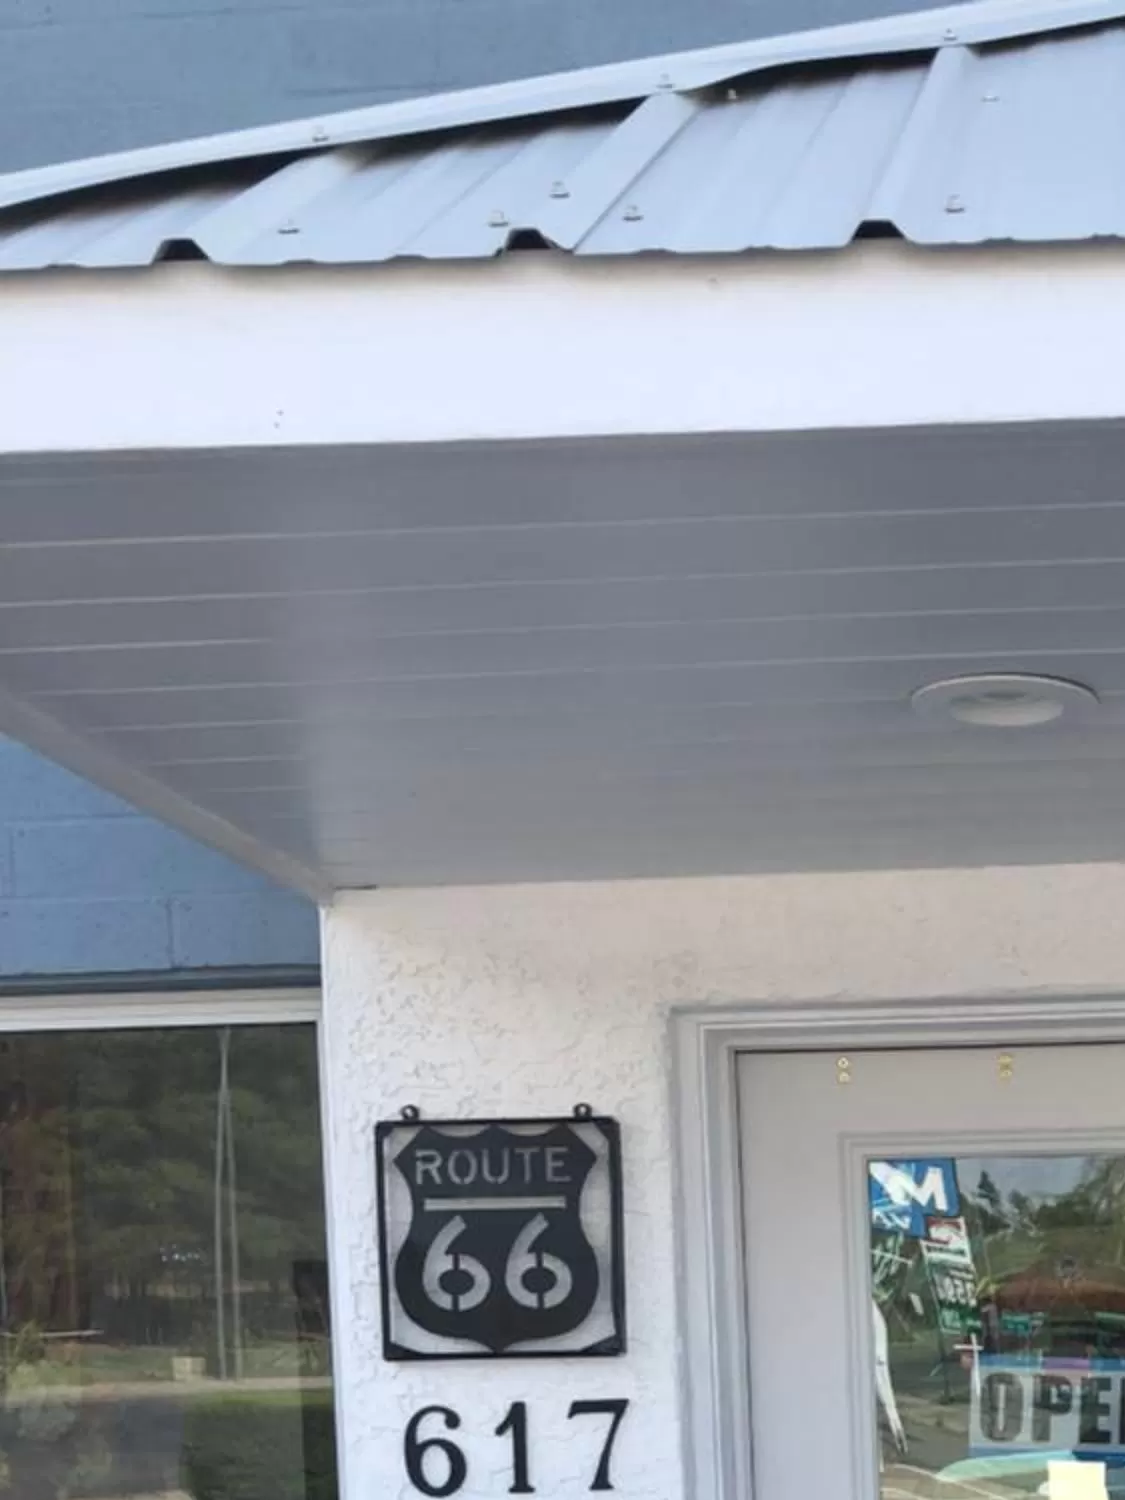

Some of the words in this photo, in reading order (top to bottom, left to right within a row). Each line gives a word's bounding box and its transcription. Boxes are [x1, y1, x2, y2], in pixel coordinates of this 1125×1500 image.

[415, 1147, 573, 1186] ROUTE
[422, 1212, 573, 1312] 66
[404, 1399, 630, 1498] 617
